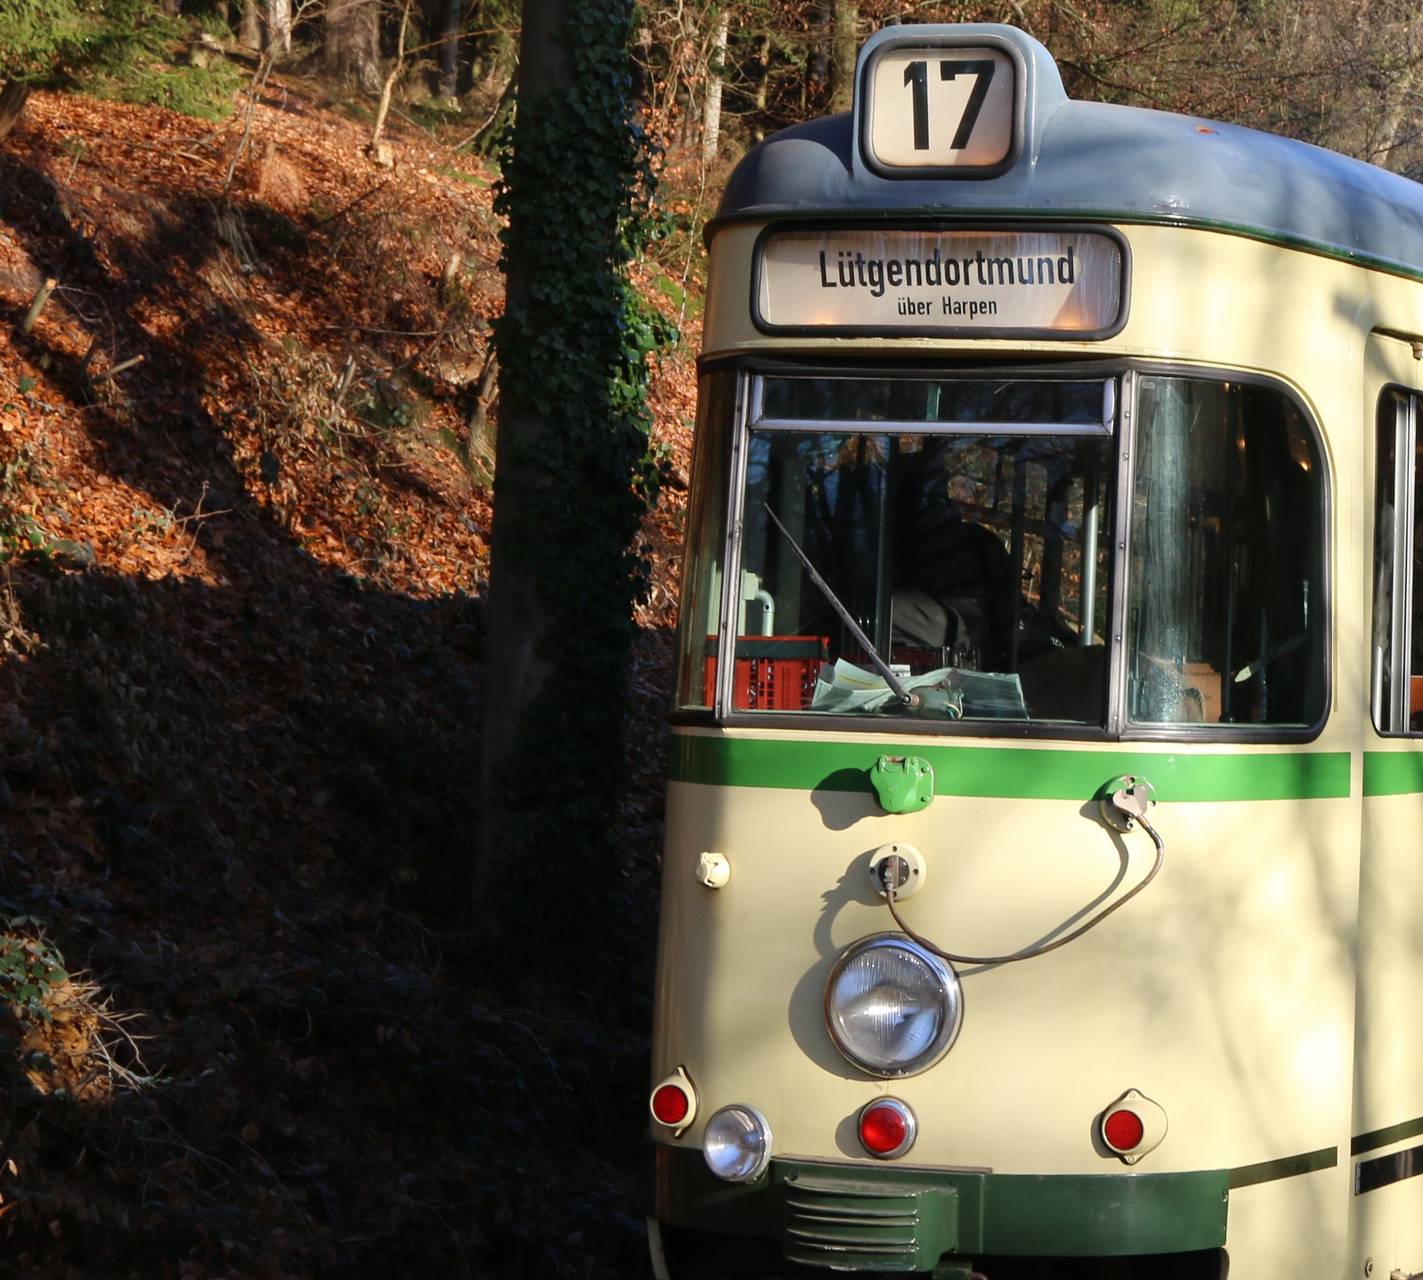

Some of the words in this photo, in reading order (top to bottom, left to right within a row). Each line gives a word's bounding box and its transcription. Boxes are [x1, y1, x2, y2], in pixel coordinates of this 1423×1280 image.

[903, 60, 995, 151] 17
[818, 246, 1076, 297] Lütgendortmund
[897, 297, 932, 316] über
[941, 296, 998, 319] Harpen
